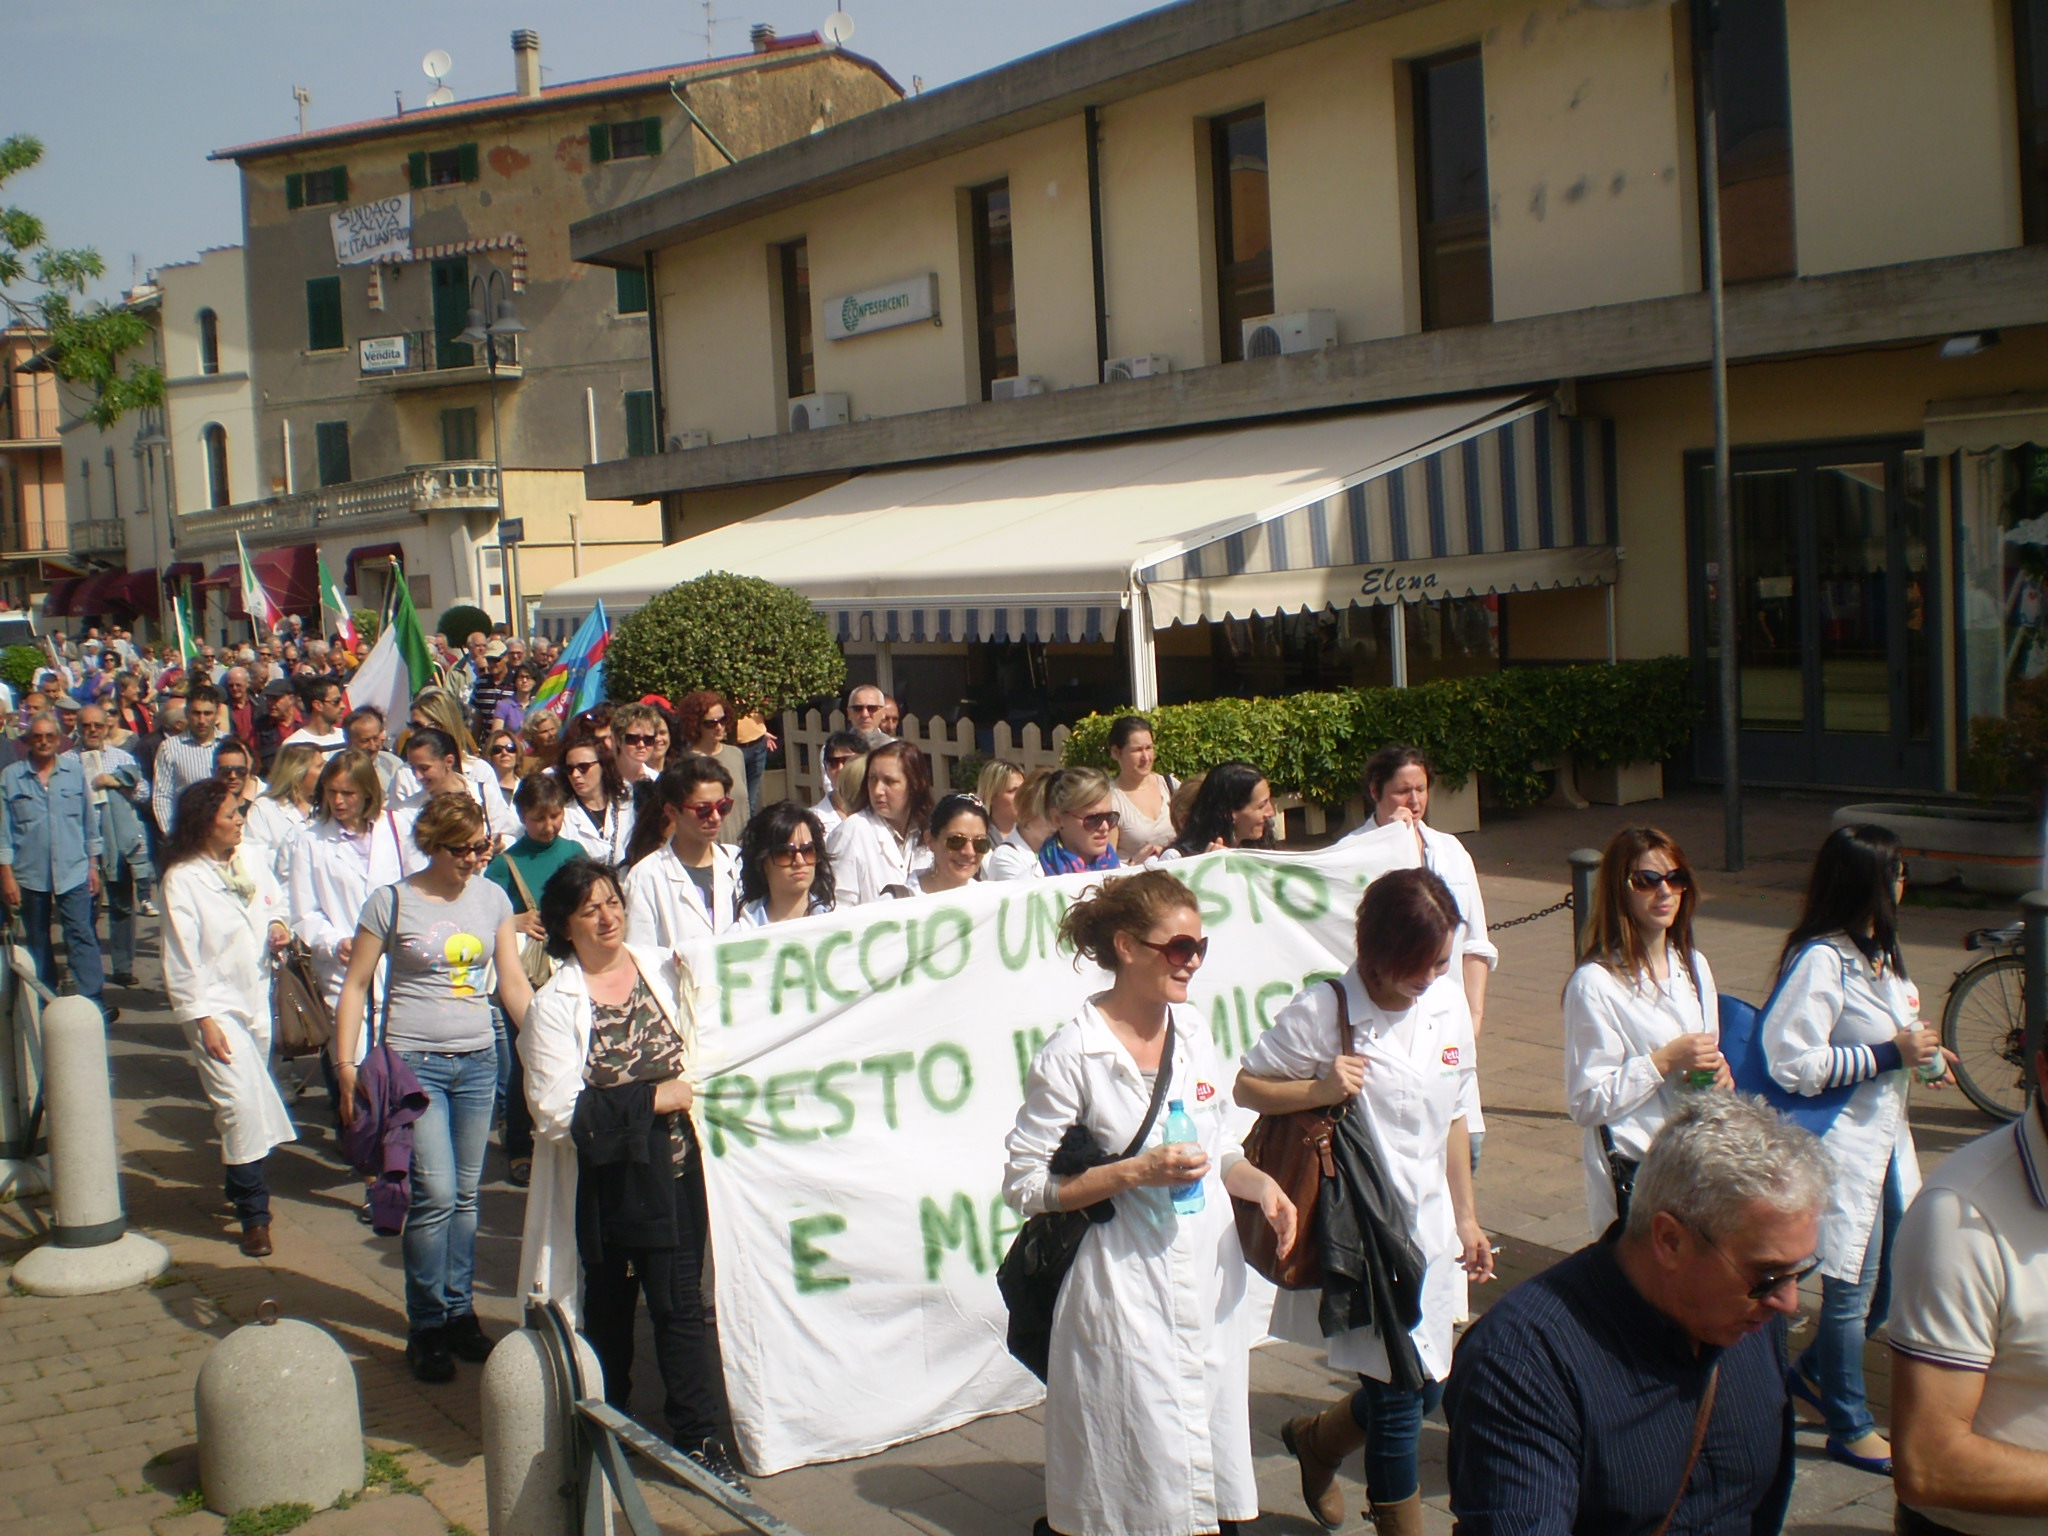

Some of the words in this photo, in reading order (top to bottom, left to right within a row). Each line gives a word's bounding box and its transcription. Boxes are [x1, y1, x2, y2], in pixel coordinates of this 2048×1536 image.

[338, 198, 402, 229] SINDACO
[350, 213, 399, 238] SALVA
[364, 349, 401, 361] Vendita
[1361, 567, 1440, 595] Elena
[714, 906, 974, 1025] FACCIO
[703, 1040, 975, 1152] RESTO
[789, 1212, 851, 1295] E
[918, 1191, 1027, 1282] MA
